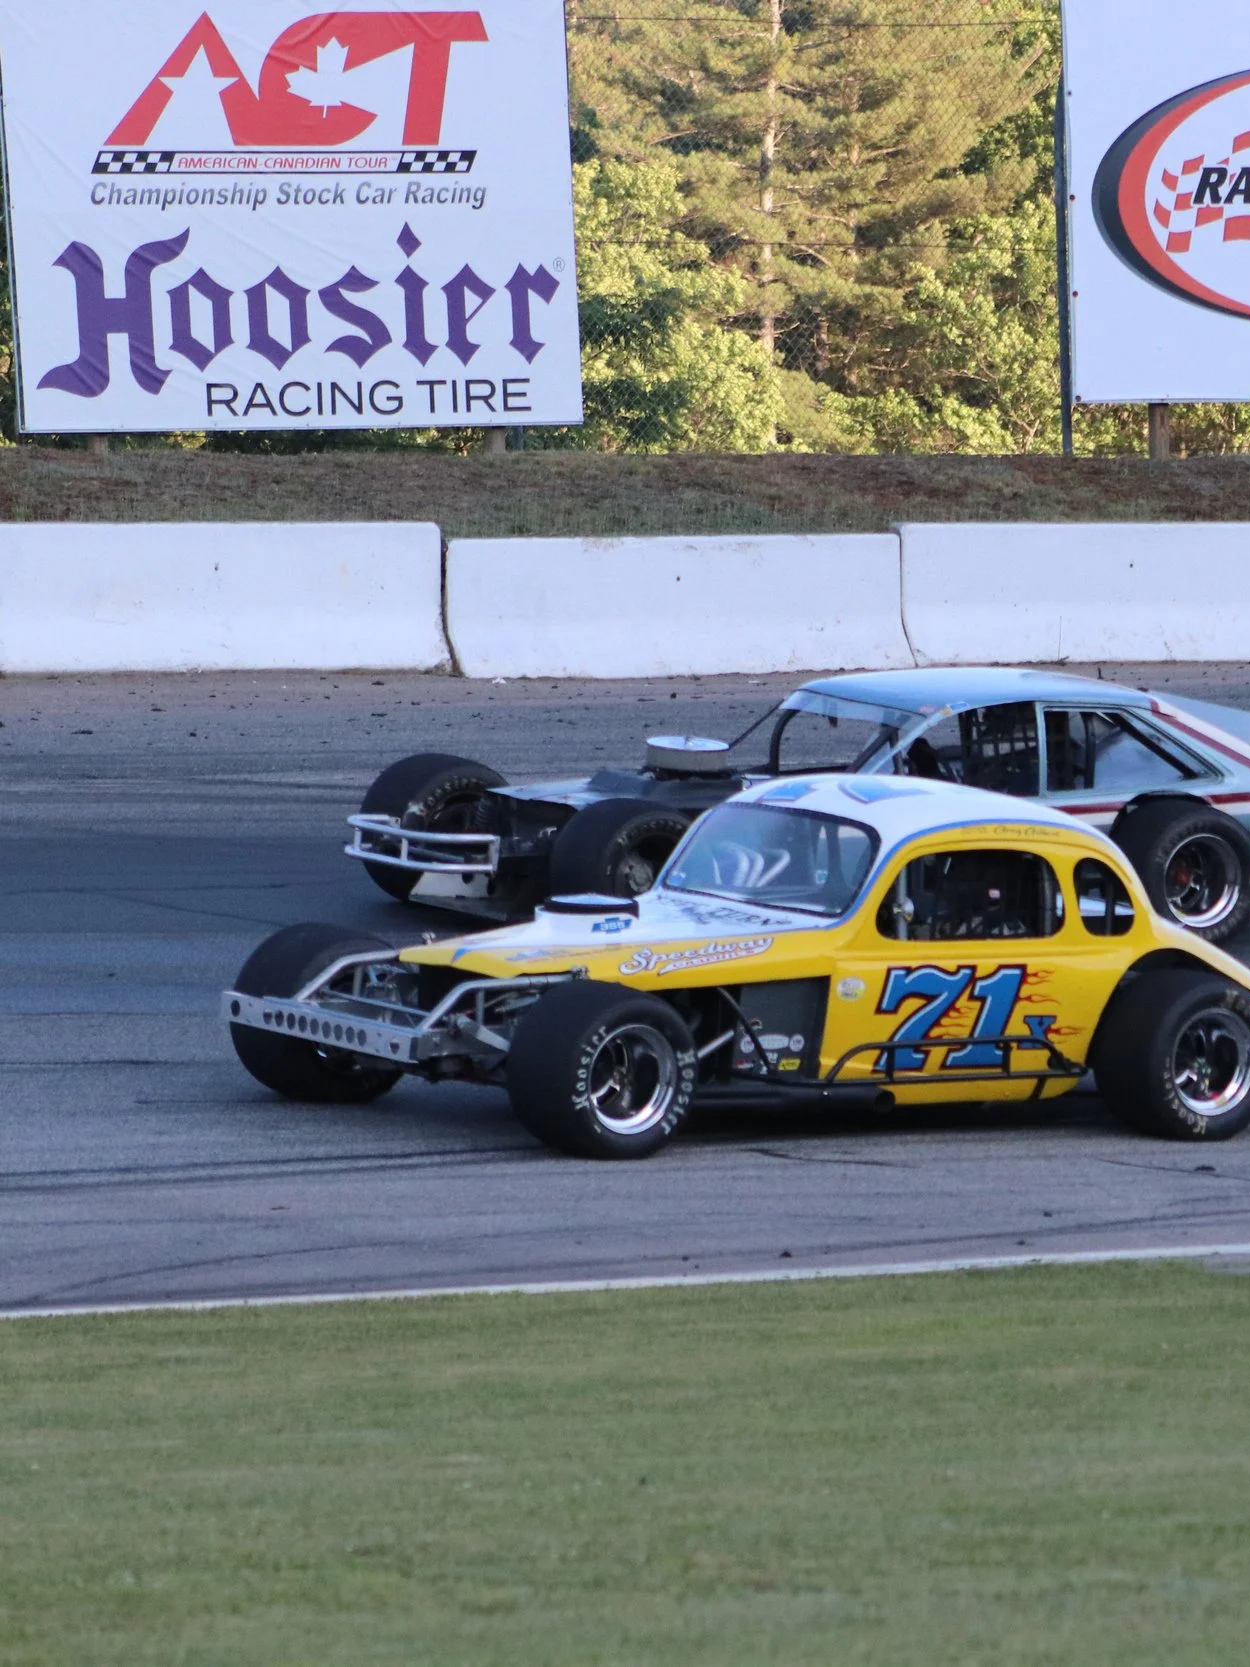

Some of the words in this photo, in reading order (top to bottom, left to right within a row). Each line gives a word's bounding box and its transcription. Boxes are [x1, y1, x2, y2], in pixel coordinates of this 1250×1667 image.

[103, 11, 488, 146] ACT
[177, 156, 341, 170] AMERICAN-CANADIAN
[346, 156, 388, 169] TOUR
[90, 181, 268, 211] Championship
[276, 182, 346, 206] Stock
[355, 181, 398, 205] Car
[404, 180, 487, 209] Racing
[36, 221, 561, 398] Hoosier
[206, 380, 404, 416] RACING
[416, 378, 532, 413] TIRE
[619, 936, 773, 976] Speedway
[571, 1025, 608, 1110] Hoosier
[660, 1049, 697, 1136] Hoosier
